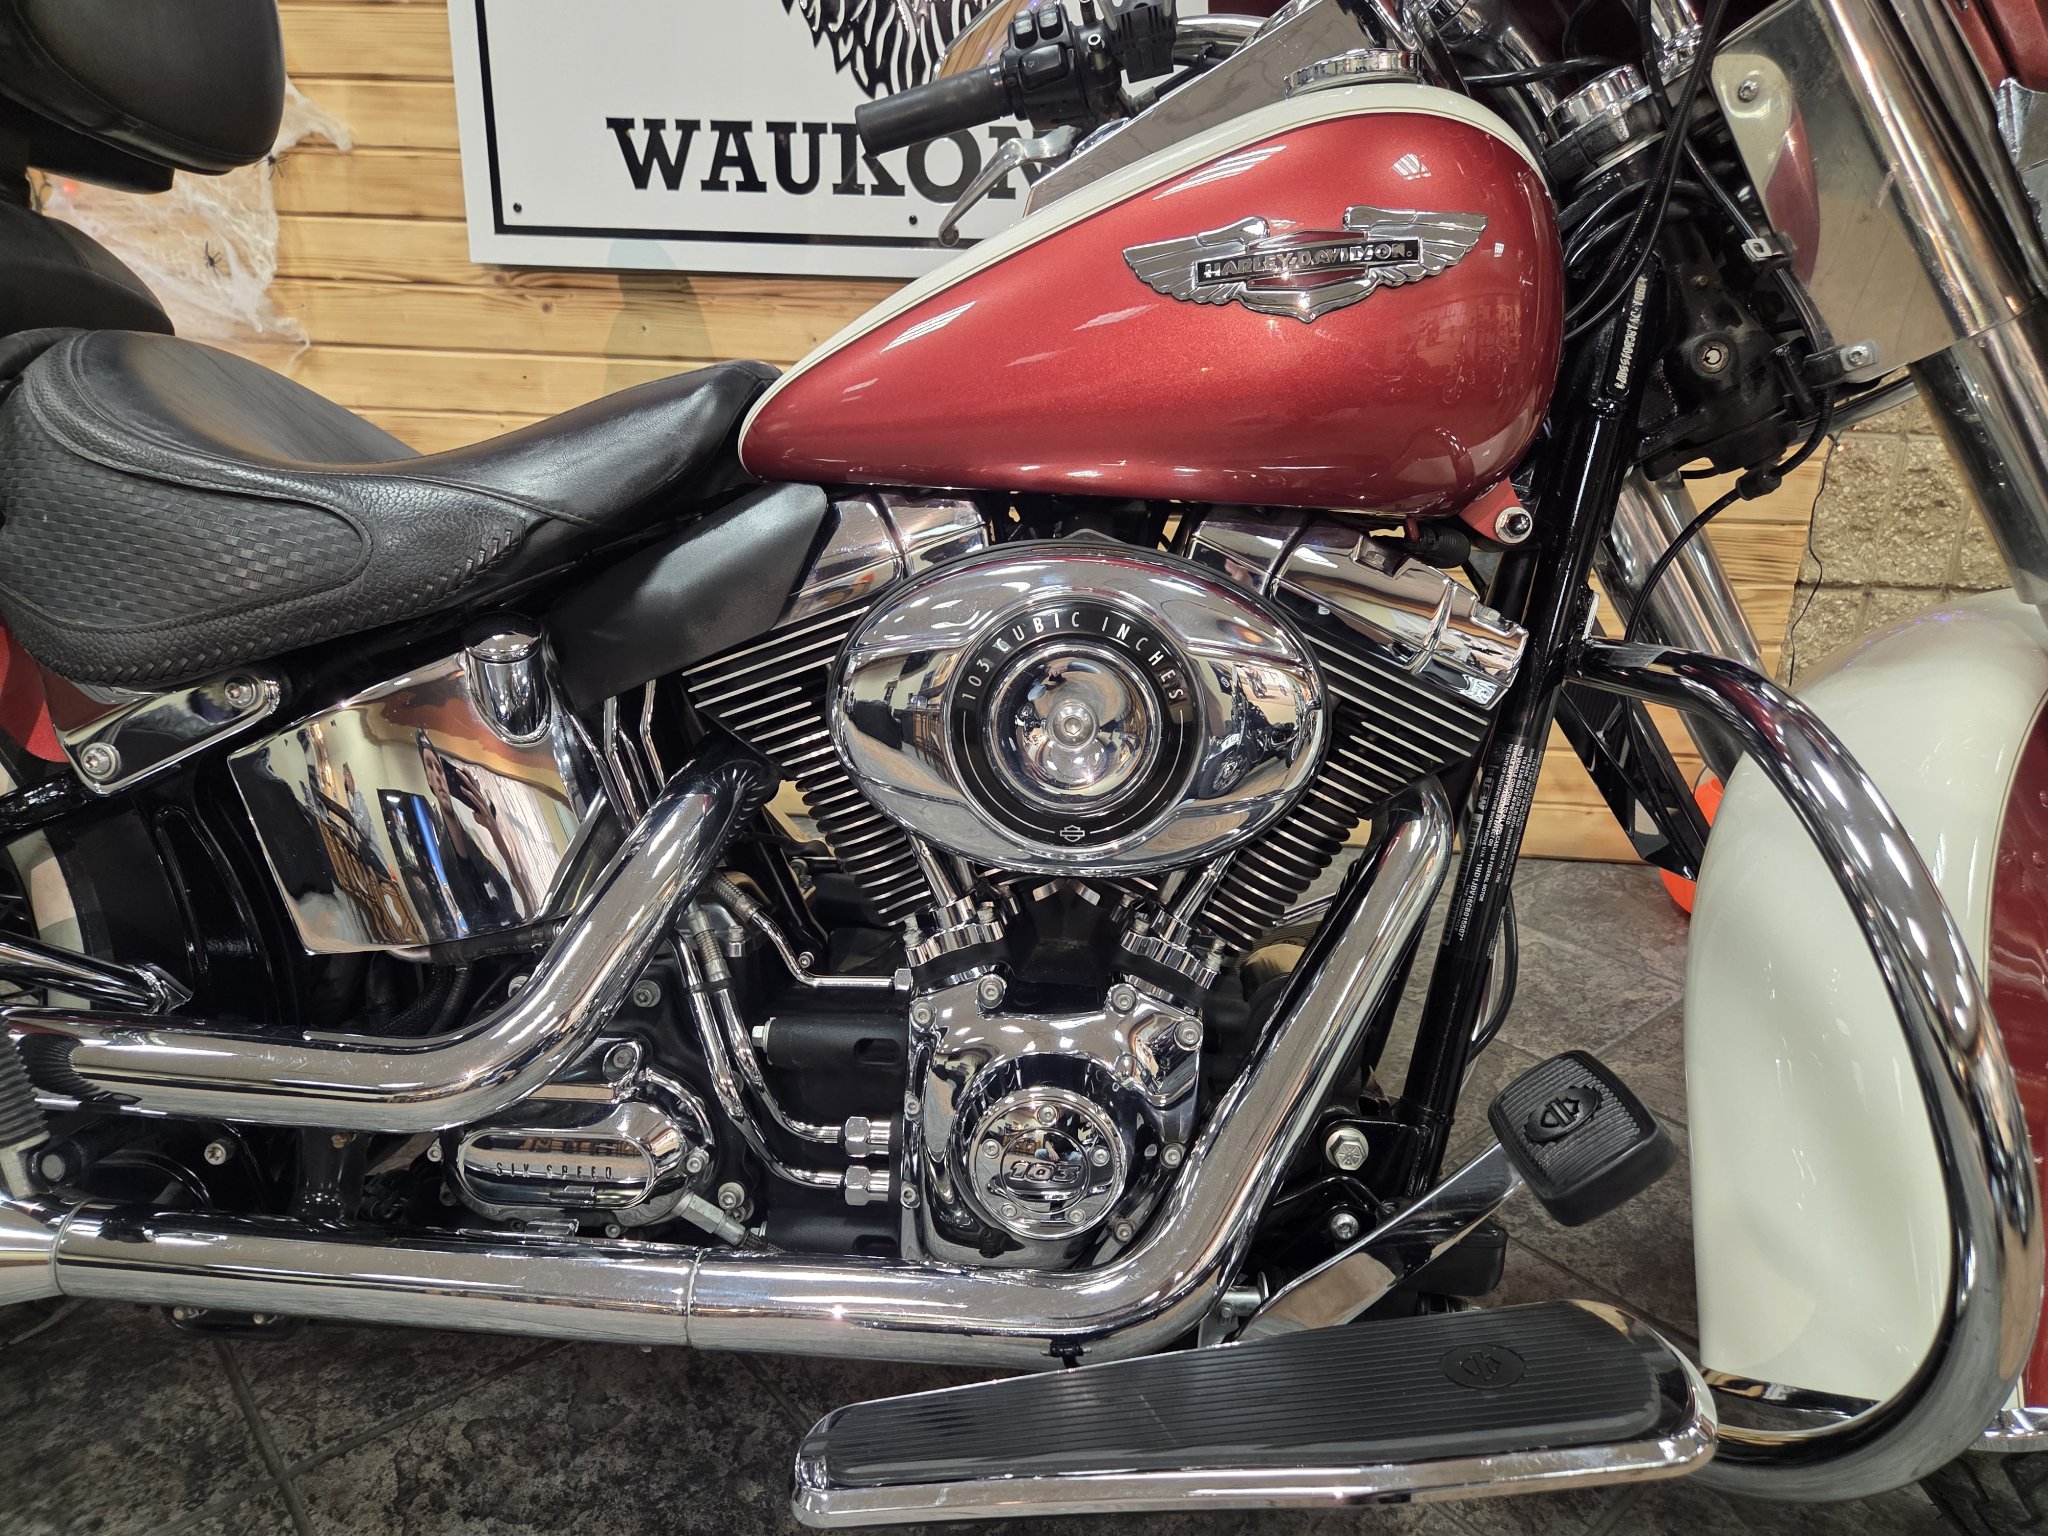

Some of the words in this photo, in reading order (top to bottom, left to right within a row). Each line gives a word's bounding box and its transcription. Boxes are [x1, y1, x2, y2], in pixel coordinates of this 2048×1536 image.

[961, 658, 990, 701] 103
[996, 611, 1081, 654] CUBIC
[1101, 616, 1184, 700] INCHES
[1491, 774, 1504, 810] MANUFACTURE
[1504, 777, 1516, 805] CONFORMS
[1481, 829, 1490, 846] ABOVE
[1491, 822, 1503, 853] APPLICABLE
[1483, 860, 1493, 883] FEDERAL
[1478, 883, 1487, 902] MOTOR
[496, 1162, 530, 1179] SIX
[546, 1164, 612, 1180] SPEED
[1009, 1160, 1082, 1183] 103
